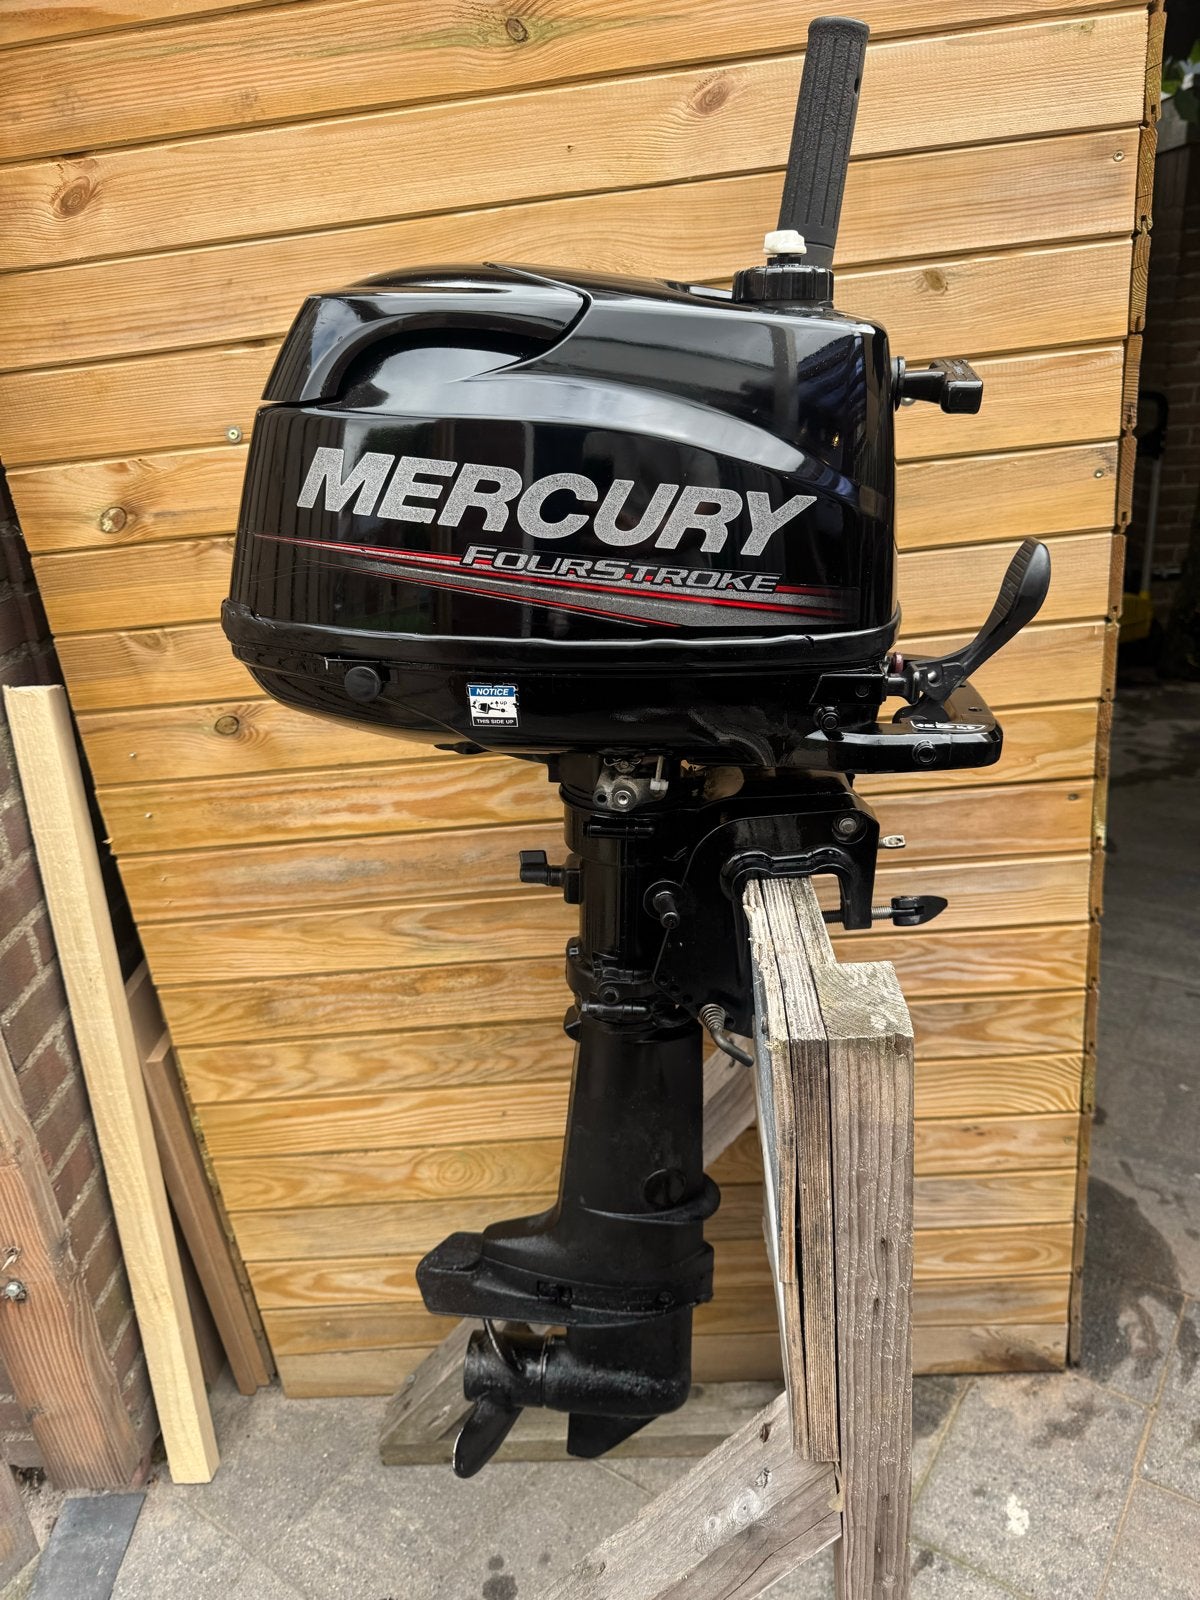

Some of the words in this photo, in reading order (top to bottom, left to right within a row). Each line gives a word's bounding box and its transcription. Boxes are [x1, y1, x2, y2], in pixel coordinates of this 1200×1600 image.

[297, 446, 817, 557] MERCURY
[462, 545, 783, 592] FOURSTROKE
[476, 688, 509, 696] NOTICE
